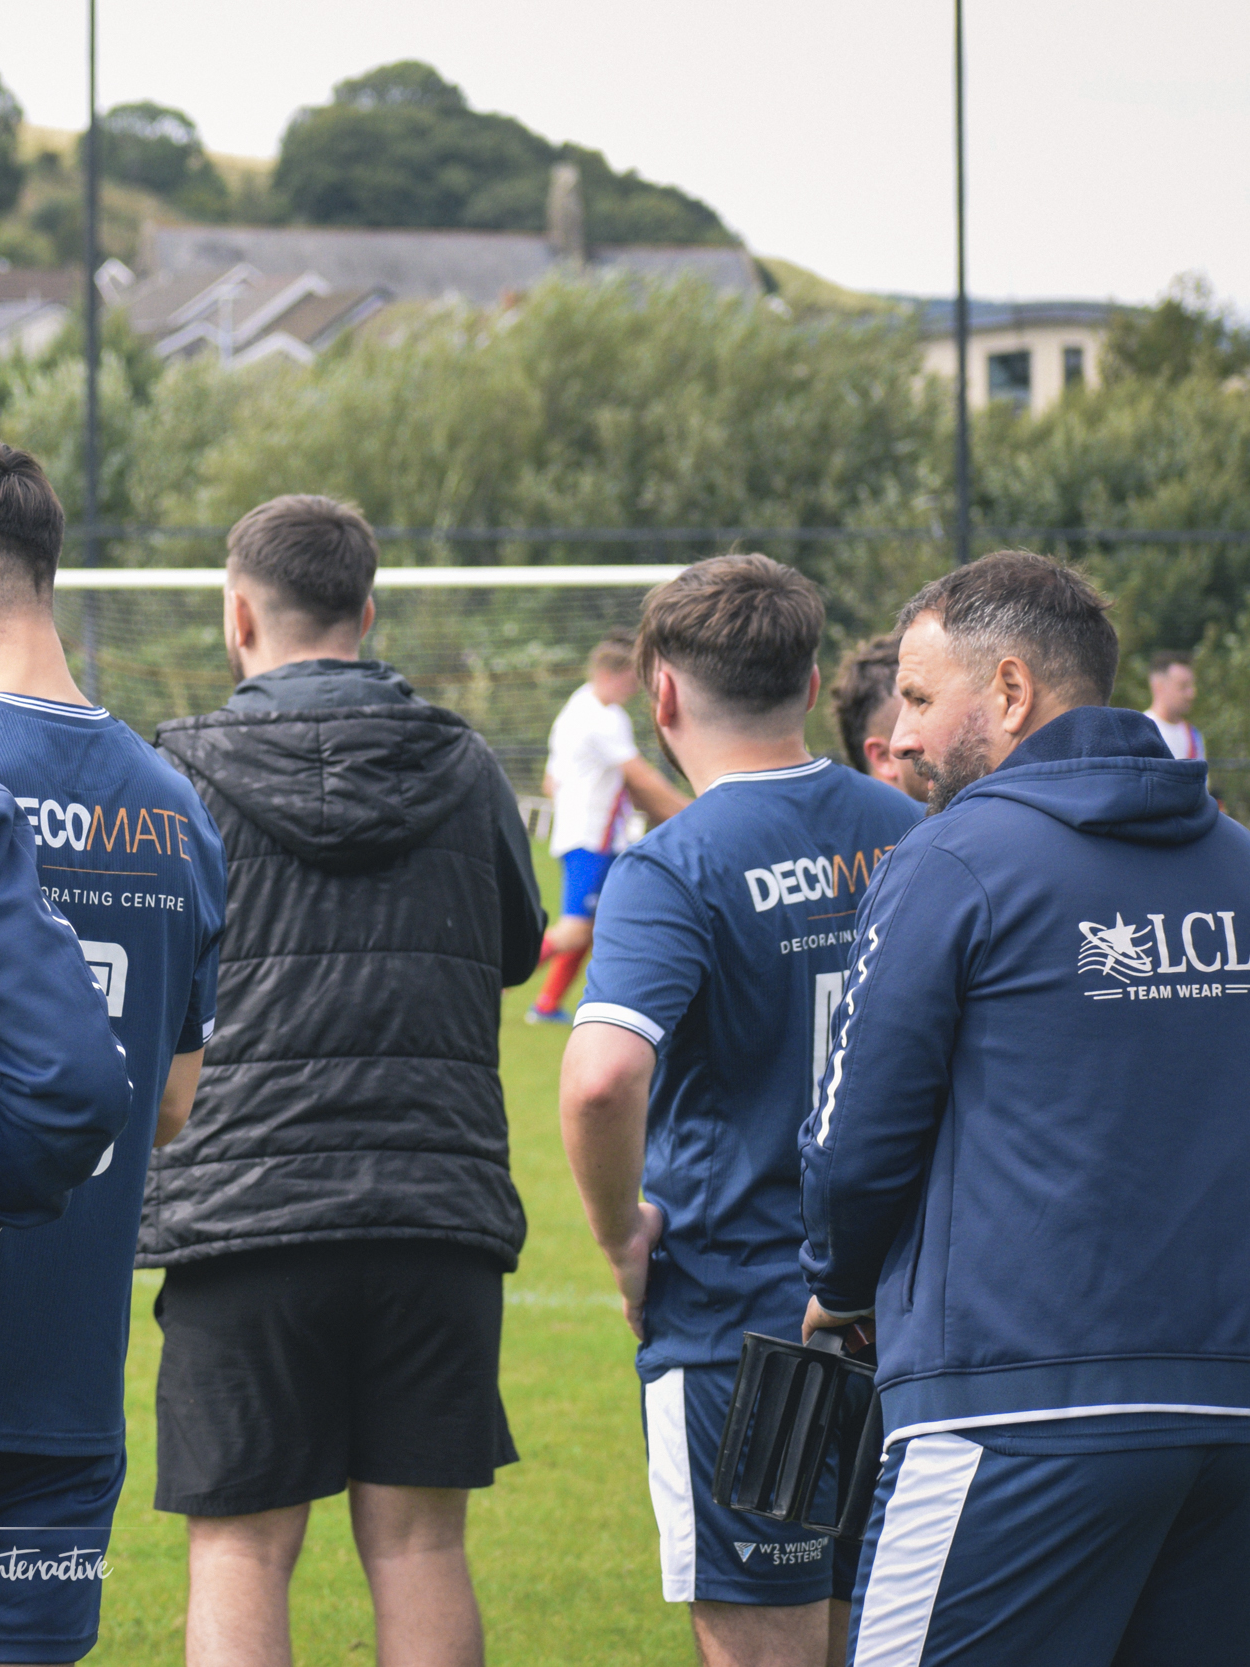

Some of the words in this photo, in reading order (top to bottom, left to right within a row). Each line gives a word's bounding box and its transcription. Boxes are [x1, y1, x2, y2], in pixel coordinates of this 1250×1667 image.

[121, 893, 185, 912] CENTRE
[1146, 911, 1250, 974] LCL
[1126, 985, 1172, 1000] TEAM
[1176, 983, 1222, 998] WEAR
[759, 1543, 780, 1554] W2
[772, 1549, 822, 1565] SYSTEMS
